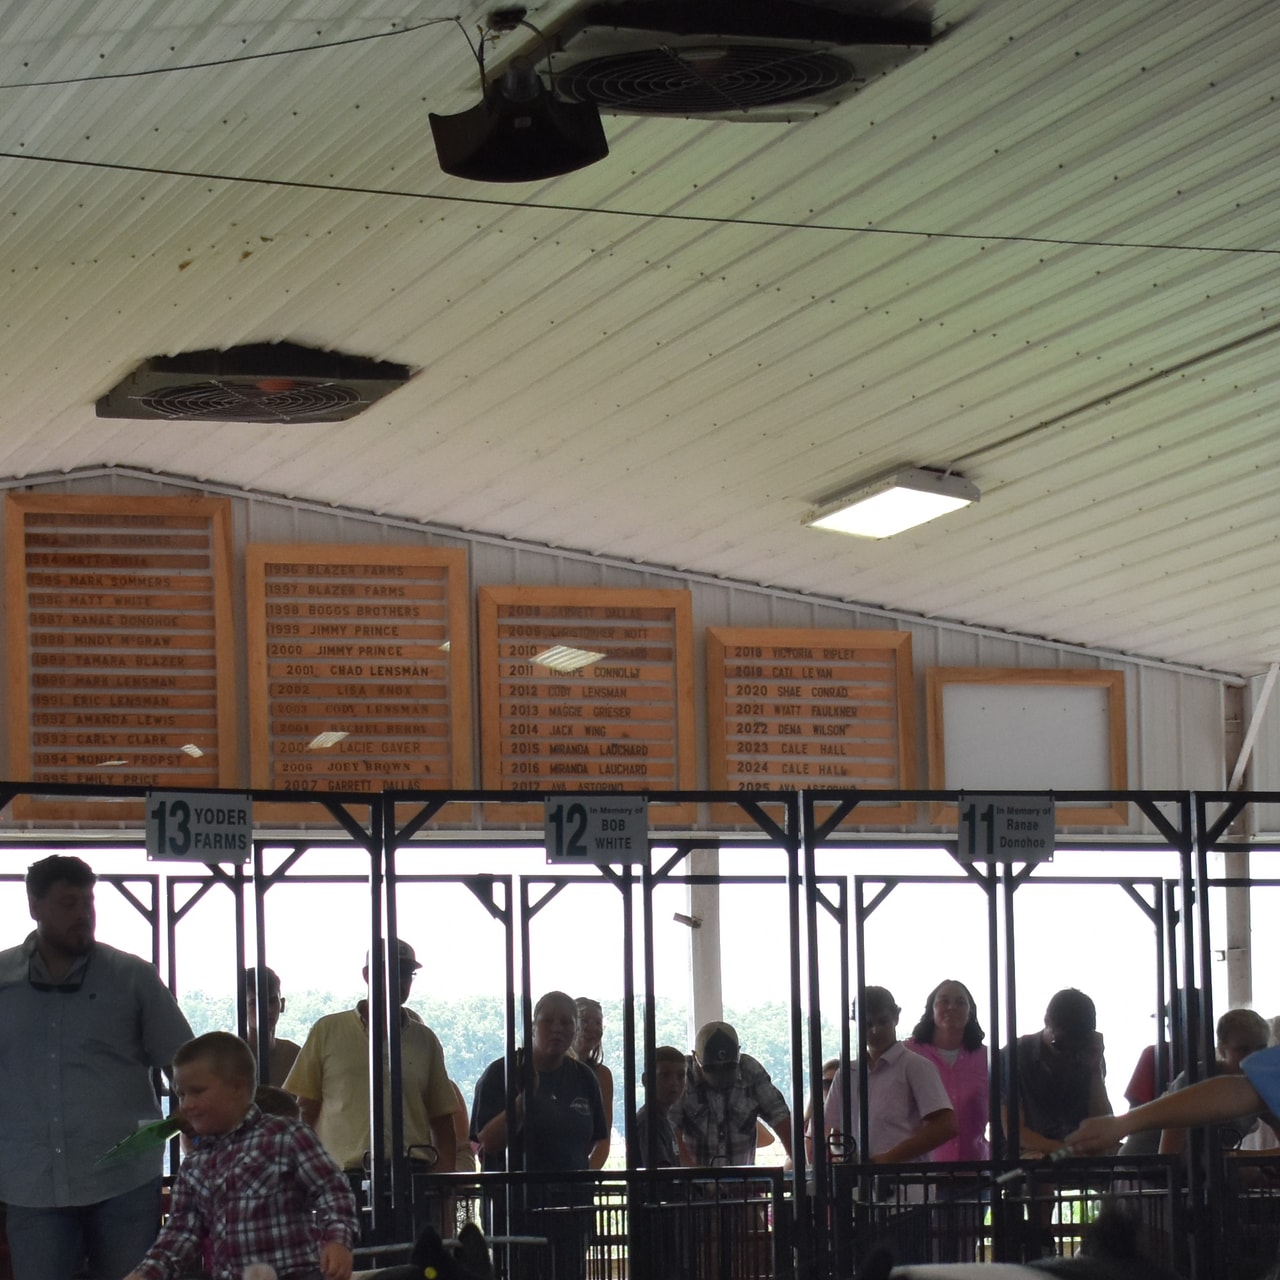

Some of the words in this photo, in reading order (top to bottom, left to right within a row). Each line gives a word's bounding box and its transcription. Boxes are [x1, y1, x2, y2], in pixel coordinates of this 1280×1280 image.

[308, 566, 355, 576] BLAZER
[364, 567, 404, 576] FARMS
[70, 576, 103, 586] MARK
[111, 577, 170, 587] SOMMERS
[269, 585, 297, 594] 1997
[308, 586, 355, 595] BLAZER
[365, 586, 405, 596] FARMS
[270, 605, 299, 615] 1998
[309, 606, 350, 616] BOGGS
[357, 607, 420, 617] BROTHERS
[509, 606, 540, 616] 2008
[271, 624, 299, 634] 1999
[310, 625, 347, 635] JIMMY
[355, 626, 399, 636] PRINCE
[509, 626, 540, 637] 2009
[272, 645, 302, 655] 2000
[317, 646, 353, 656] JIMMY
[359, 646, 402, 656] PRINCE
[509, 645, 537, 656] 2010
[735, 647, 762, 658] 2018
[772, 648, 813, 660] VICTORIA
[824, 649, 856, 660] RIPLEY
[287, 665, 314, 675] 2001
[330, 665, 363, 676] CHAD
[370, 666, 429, 677] LENSMAN
[509, 665, 533, 676] 2011
[594, 667, 640, 679] CONNOLLY
[736, 666, 763, 677] 2019
[278, 684, 310, 695] 2002
[338, 685, 366, 695] LISA
[379, 686, 412, 696] KNOX
[510, 686, 537, 696] 2012
[583, 687, 626, 698] LENSMAN
[736, 685, 768, 696] 2020
[777, 686, 801, 697] SHAE
[812, 687, 848, 698] CONRAD
[73, 696, 100, 706] ERIC
[110, 697, 168, 706] LENSMAN
[325, 705, 355, 714] CODY
[367, 705, 429, 714] LENSMAN
[511, 705, 539, 716] 2013
[549, 706, 583, 717] MAGGIE
[593, 707, 631, 718] GRIESER
[736, 703, 764, 715] 2021
[774, 705, 801, 716] WYATT
[811, 706, 857, 718] FAULKNER
[76, 715, 128, 725] AMANDA
[138, 716, 176, 725] LEWIS
[510, 724, 539, 735] 2014
[549, 725, 573, 736] JACK
[584, 726, 606, 737] WING
[737, 723, 769, 734] 2022
[778, 724, 802, 735] DENA
[813, 725, 846, 736] WILSON
[76, 735, 116, 745] CARLY
[127, 735, 167, 745] CLARK
[340, 743, 372, 753] LACIE
[382, 743, 421, 753] GAVER
[511, 743, 539, 754] 2015
[550, 744, 589, 755] MIRANDA
[600, 744, 648, 756] LAUCHARD
[737, 742, 769, 753] 2023
[782, 744, 808, 754] CALE
[820, 745, 846, 756] HALL
[282, 763, 312, 772] 2006
[327, 763, 359, 772] JOEY
[365, 763, 410, 772] BROWN
[512, 763, 539, 773] 2016
[550, 764, 588, 775] MIRANDA
[599, 764, 647, 775] LAUCHARD
[738, 761, 769, 773] 2024
[782, 764, 809, 775] CALE
[819, 764, 846, 776] HALL
[77, 775, 113, 785] EMILY
[124, 775, 159, 785] PRICE
[285, 780, 317, 790] 2007
[328, 780, 371, 791] GARRETT
[383, 780, 420, 790] DALLAS
[512, 782, 540, 791] 2017
[738, 782, 769, 791] 2025
[194, 808, 247, 825] YODER
[600, 807, 632, 815] Memory
[997, 807, 1004, 815] In
[1007, 807, 1040, 816] Memory
[1042, 807, 1051, 815] of
[152, 800, 191, 856] 13
[549, 803, 587, 856] 12
[601, 819, 625, 831] BOB
[962, 804, 994, 854] 11
[1007, 819, 1039, 831] Ranae
[194, 833, 246, 850] FARMS
[595, 837, 632, 849] WHITE
